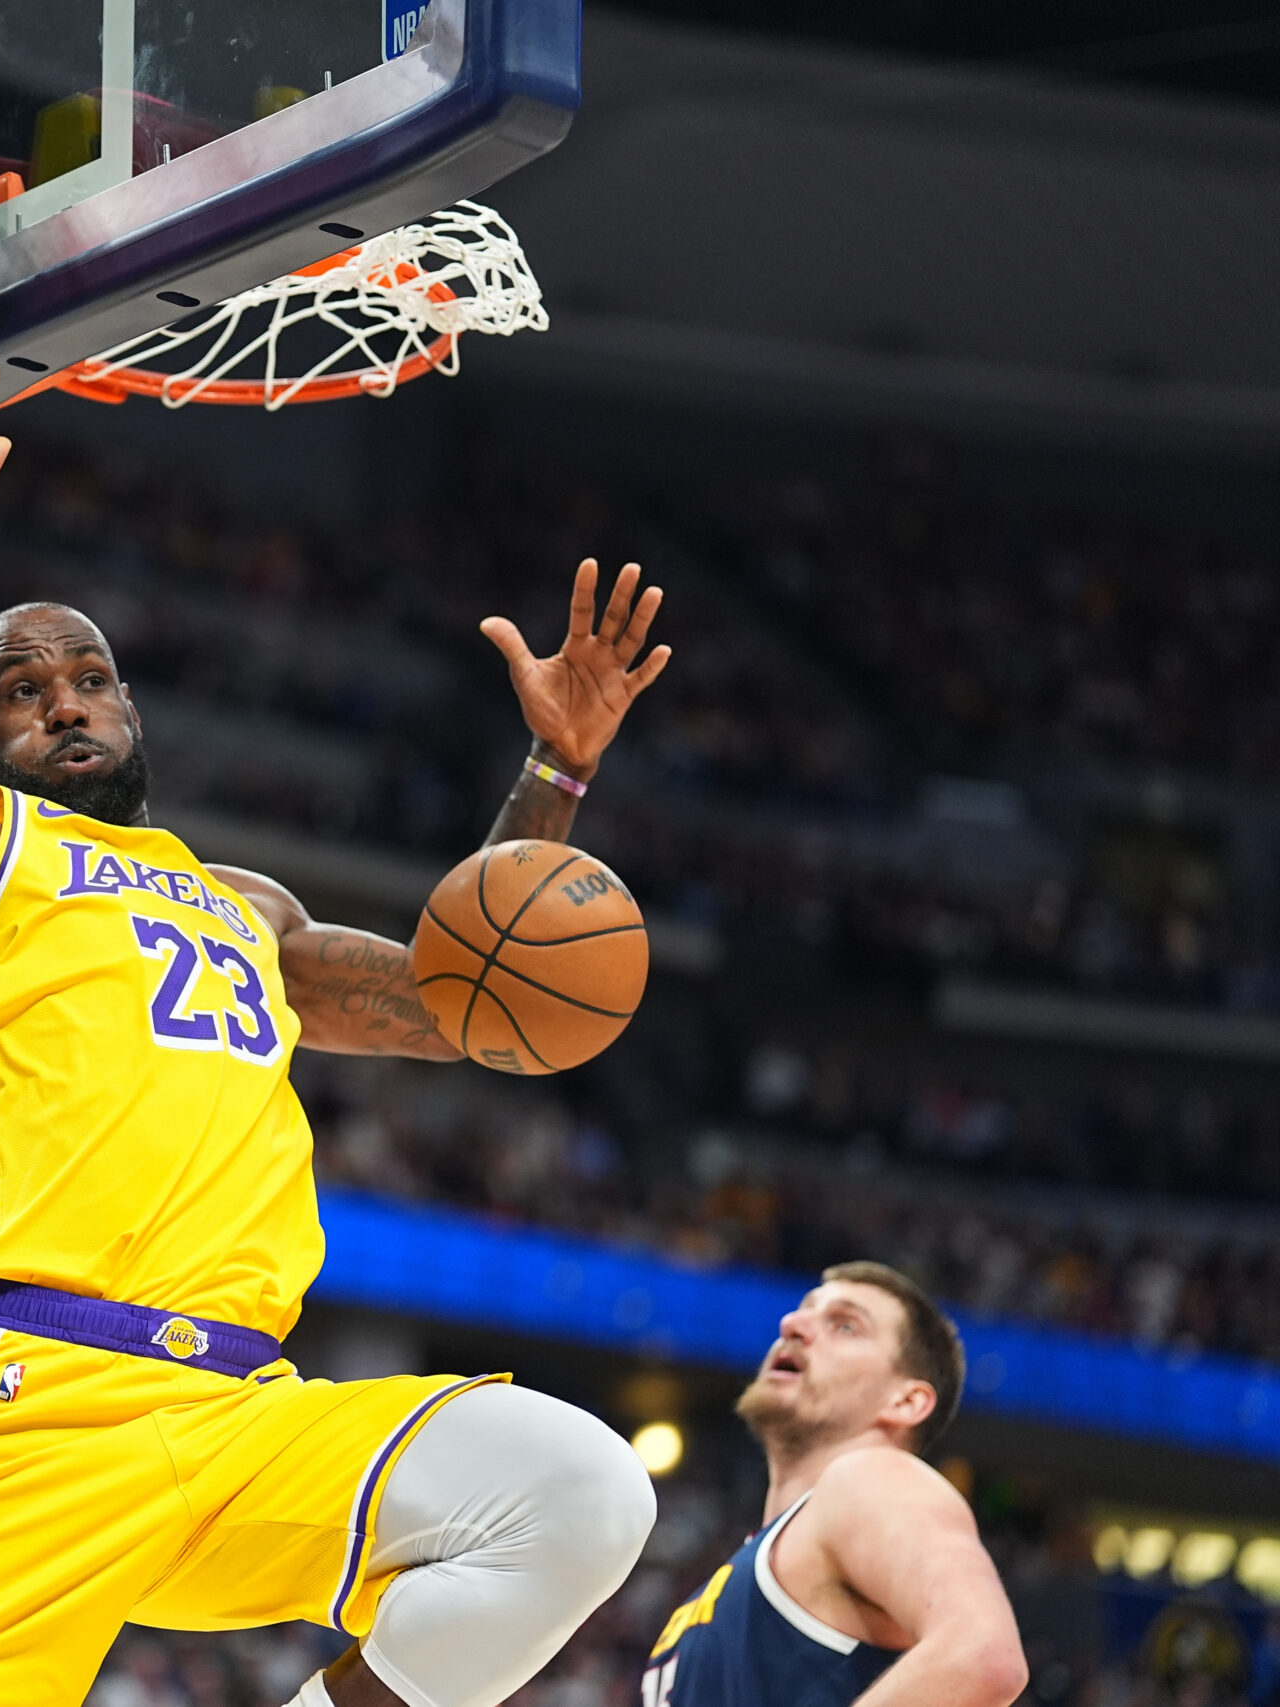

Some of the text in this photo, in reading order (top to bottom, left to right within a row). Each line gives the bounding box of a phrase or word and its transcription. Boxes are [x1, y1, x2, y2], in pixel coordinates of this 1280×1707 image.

[57, 841, 260, 945] LAKERS
[129, 912, 282, 1066] 23
[156, 1324, 206, 1352] LAKERS
